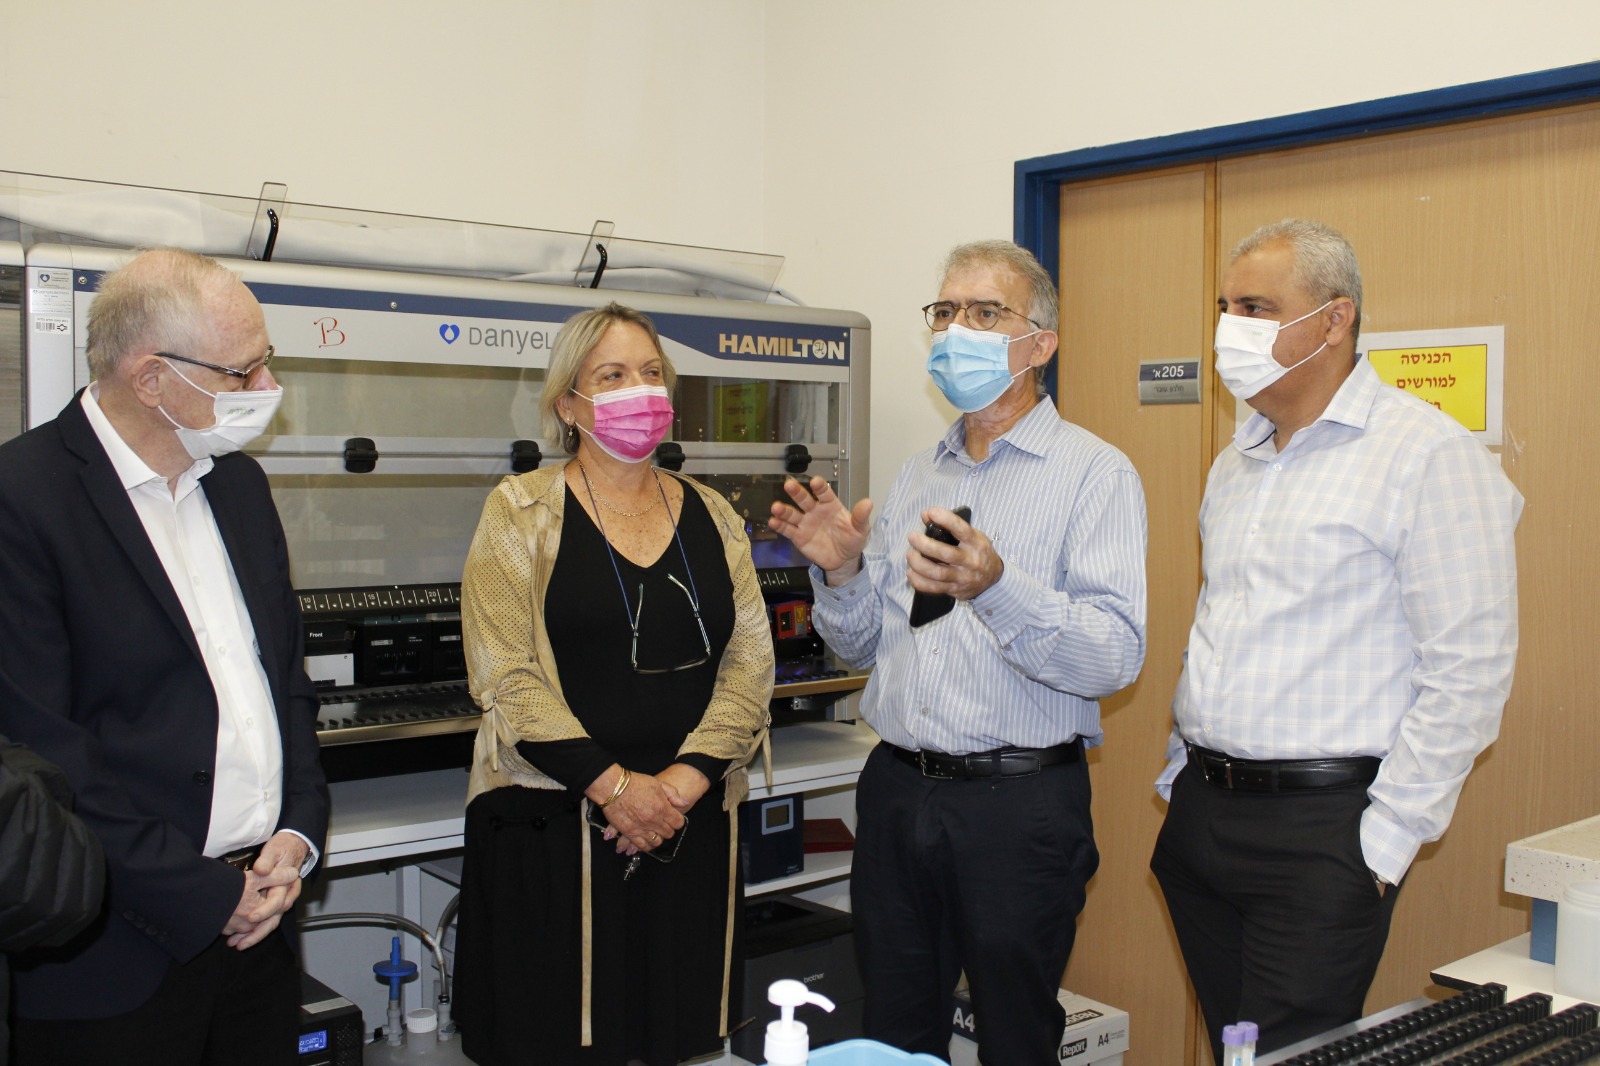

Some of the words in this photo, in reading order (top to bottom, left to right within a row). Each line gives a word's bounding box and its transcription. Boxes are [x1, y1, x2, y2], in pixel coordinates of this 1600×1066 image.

[719, 333, 845, 360] HAMILTON
[1400, 352, 1452, 365] הכניסה
[1396, 374, 1456, 389] למורשים
[803, 972, 825, 984] brother
[952, 1006, 976, 1033] A4
[1062, 1041, 1086, 1057] Report
[1097, 1032, 1110, 1047] A4
